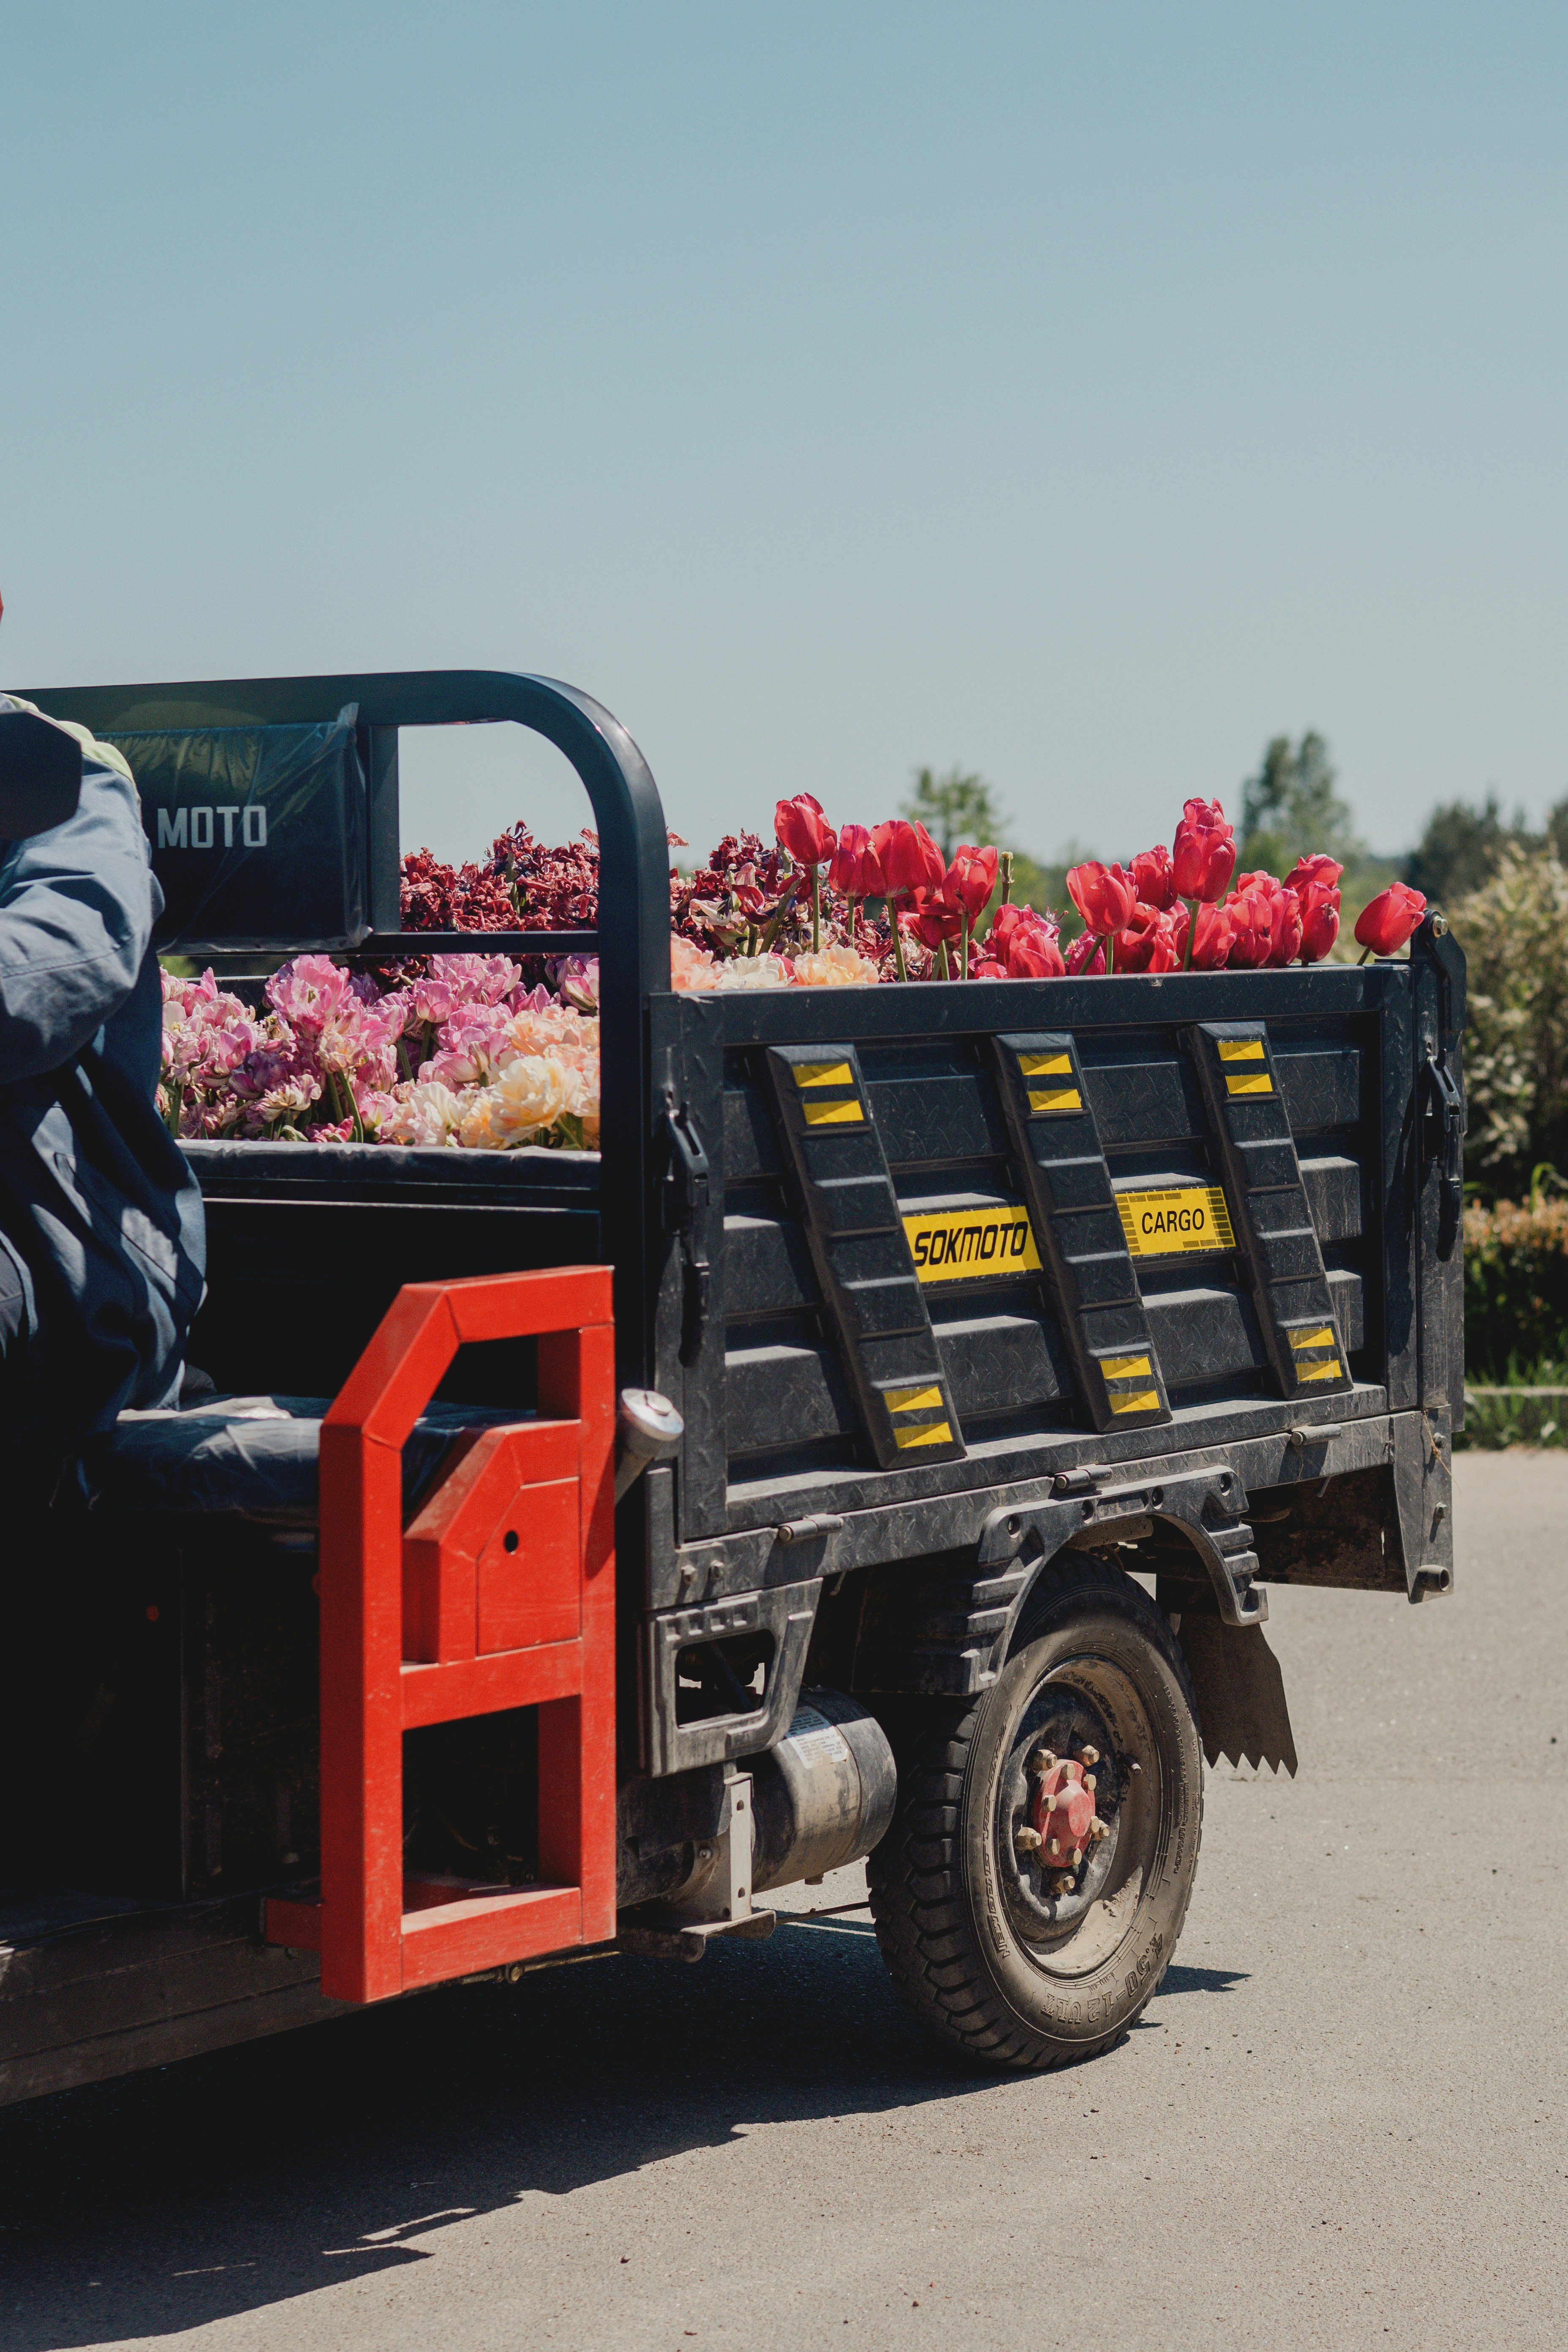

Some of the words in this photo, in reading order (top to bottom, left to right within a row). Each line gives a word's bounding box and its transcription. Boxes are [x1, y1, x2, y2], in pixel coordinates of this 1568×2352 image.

[158, 805, 267, 848] MOTO
[1142, 1208, 1205, 1234] CARGO
[914, 1221, 1028, 1267] SOKMOTO
